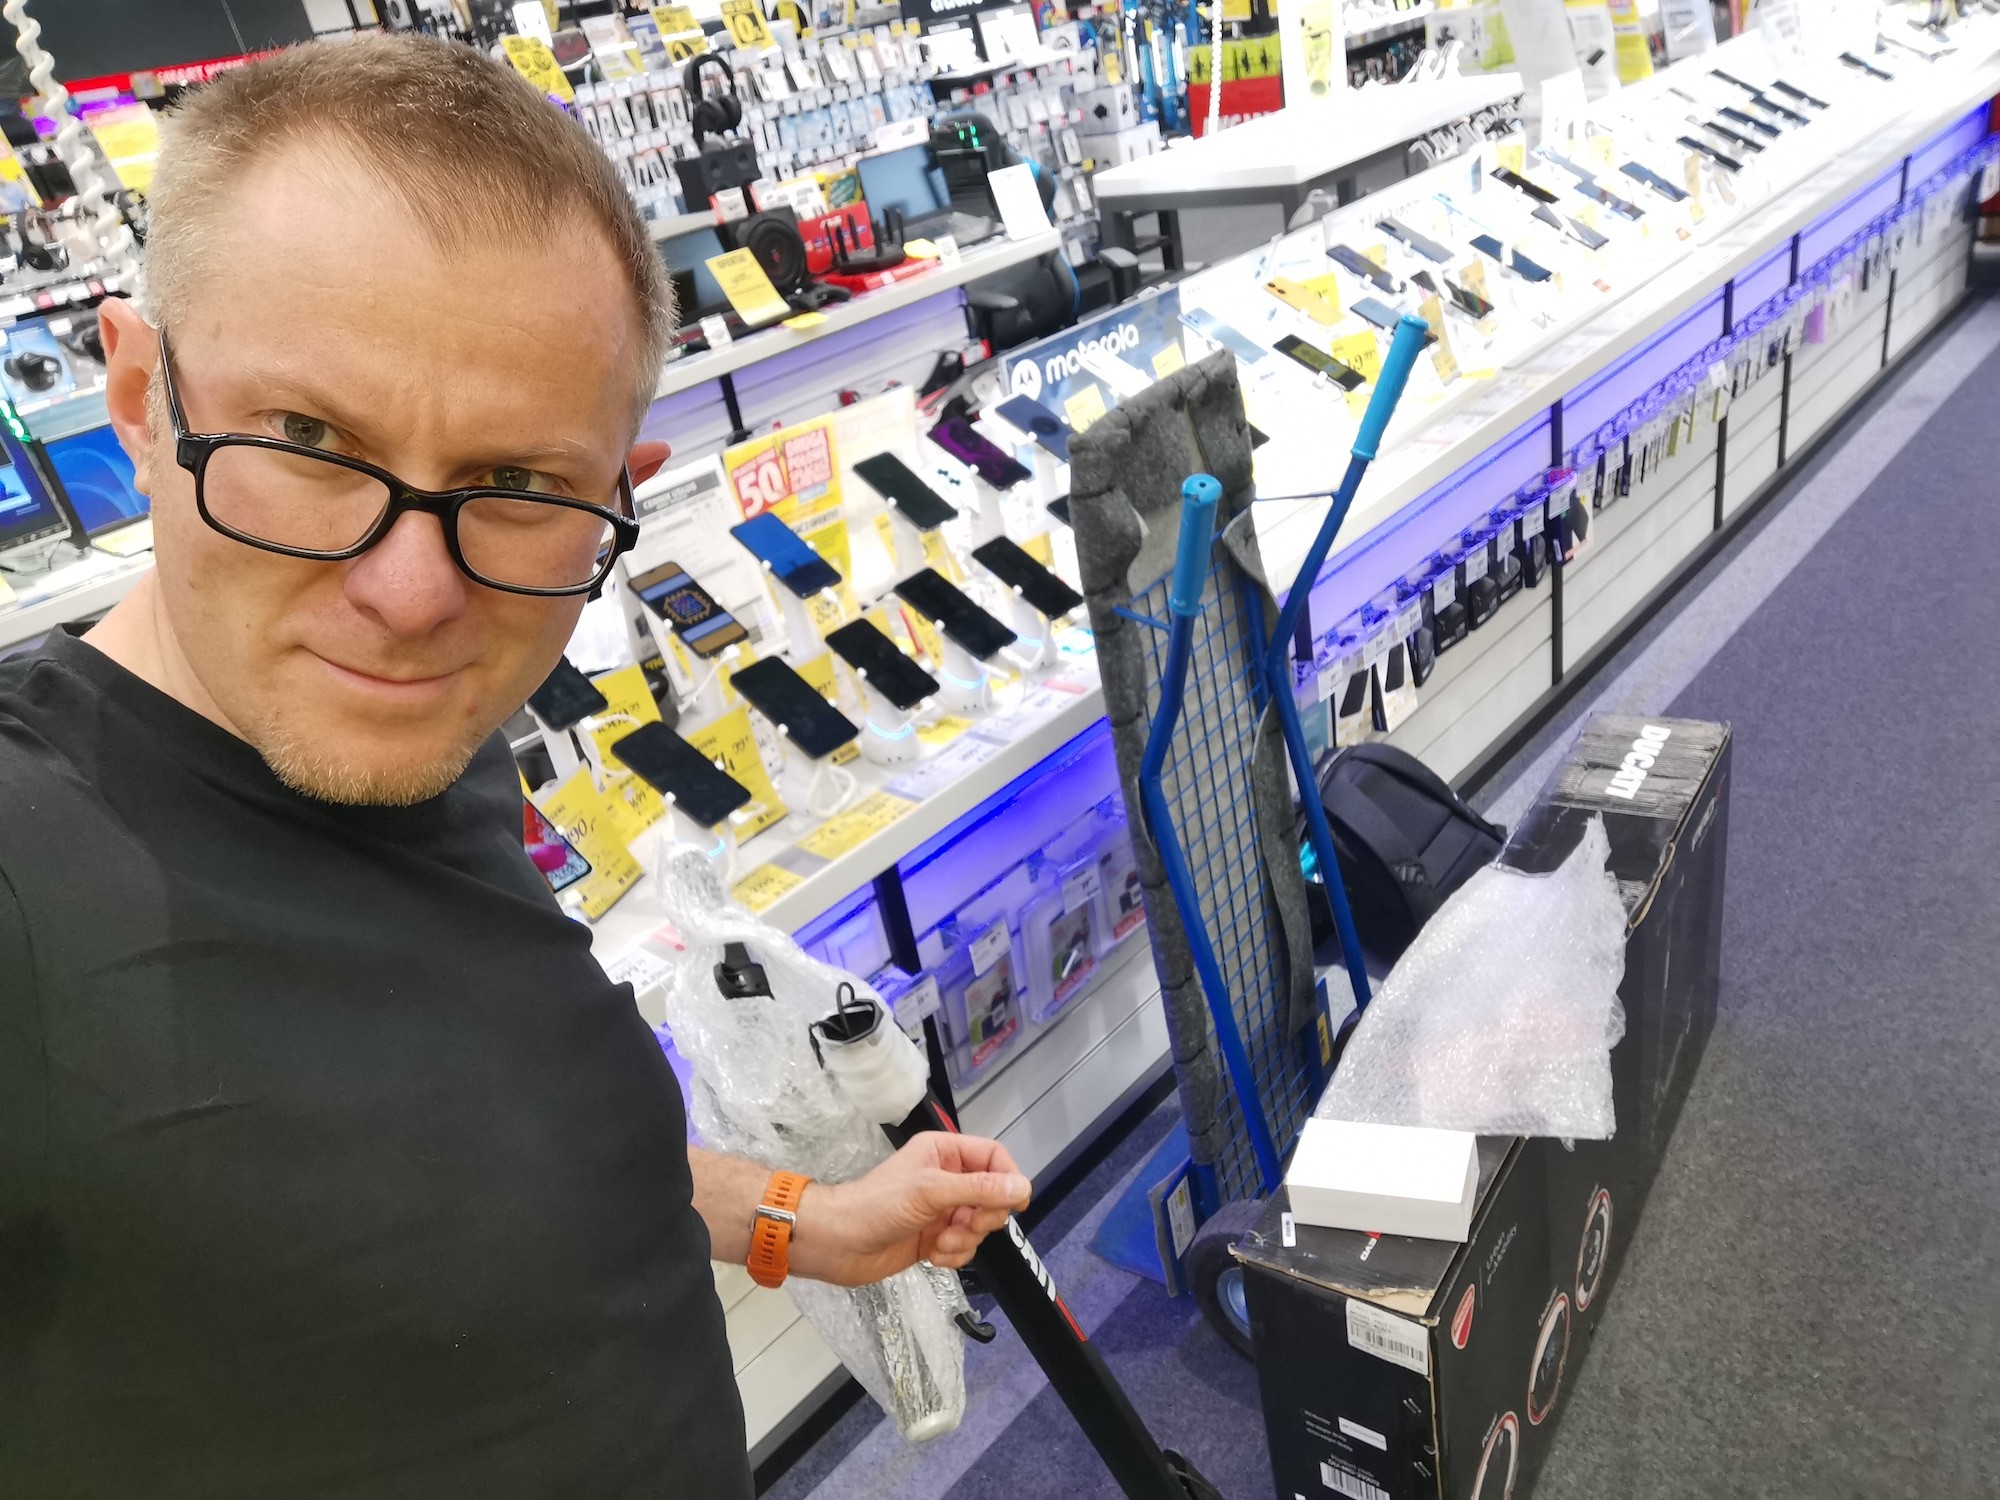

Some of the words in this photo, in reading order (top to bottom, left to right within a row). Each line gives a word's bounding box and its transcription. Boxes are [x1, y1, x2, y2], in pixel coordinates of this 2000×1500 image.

[1605, 724, 1672, 800] DUCATI
[1008, 1213, 1057, 1302] CATI
[1359, 1237, 1378, 1262] EVO
